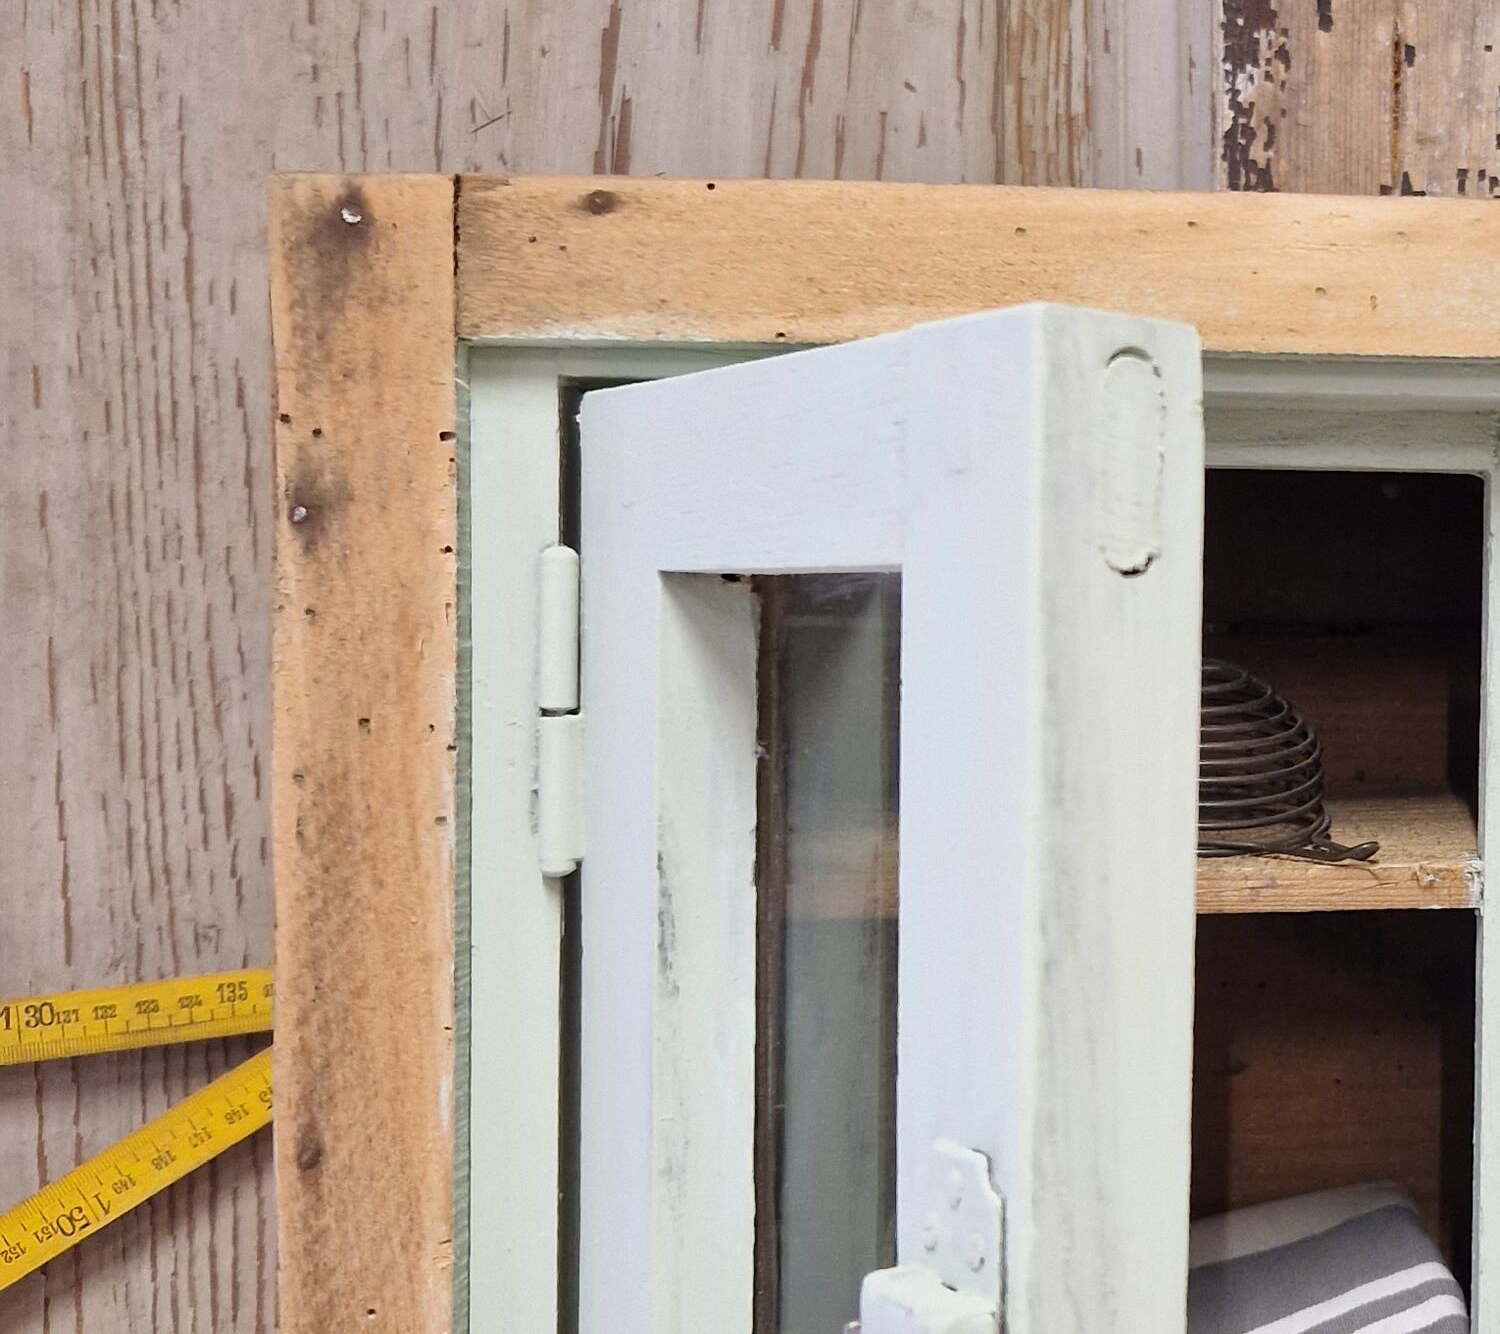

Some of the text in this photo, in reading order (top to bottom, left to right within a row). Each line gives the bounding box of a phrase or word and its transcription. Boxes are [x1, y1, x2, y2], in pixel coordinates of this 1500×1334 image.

[24, 1002, 55, 1028] 30
[216, 980, 249, 1004] 135
[56, 1205, 92, 1238] 50
